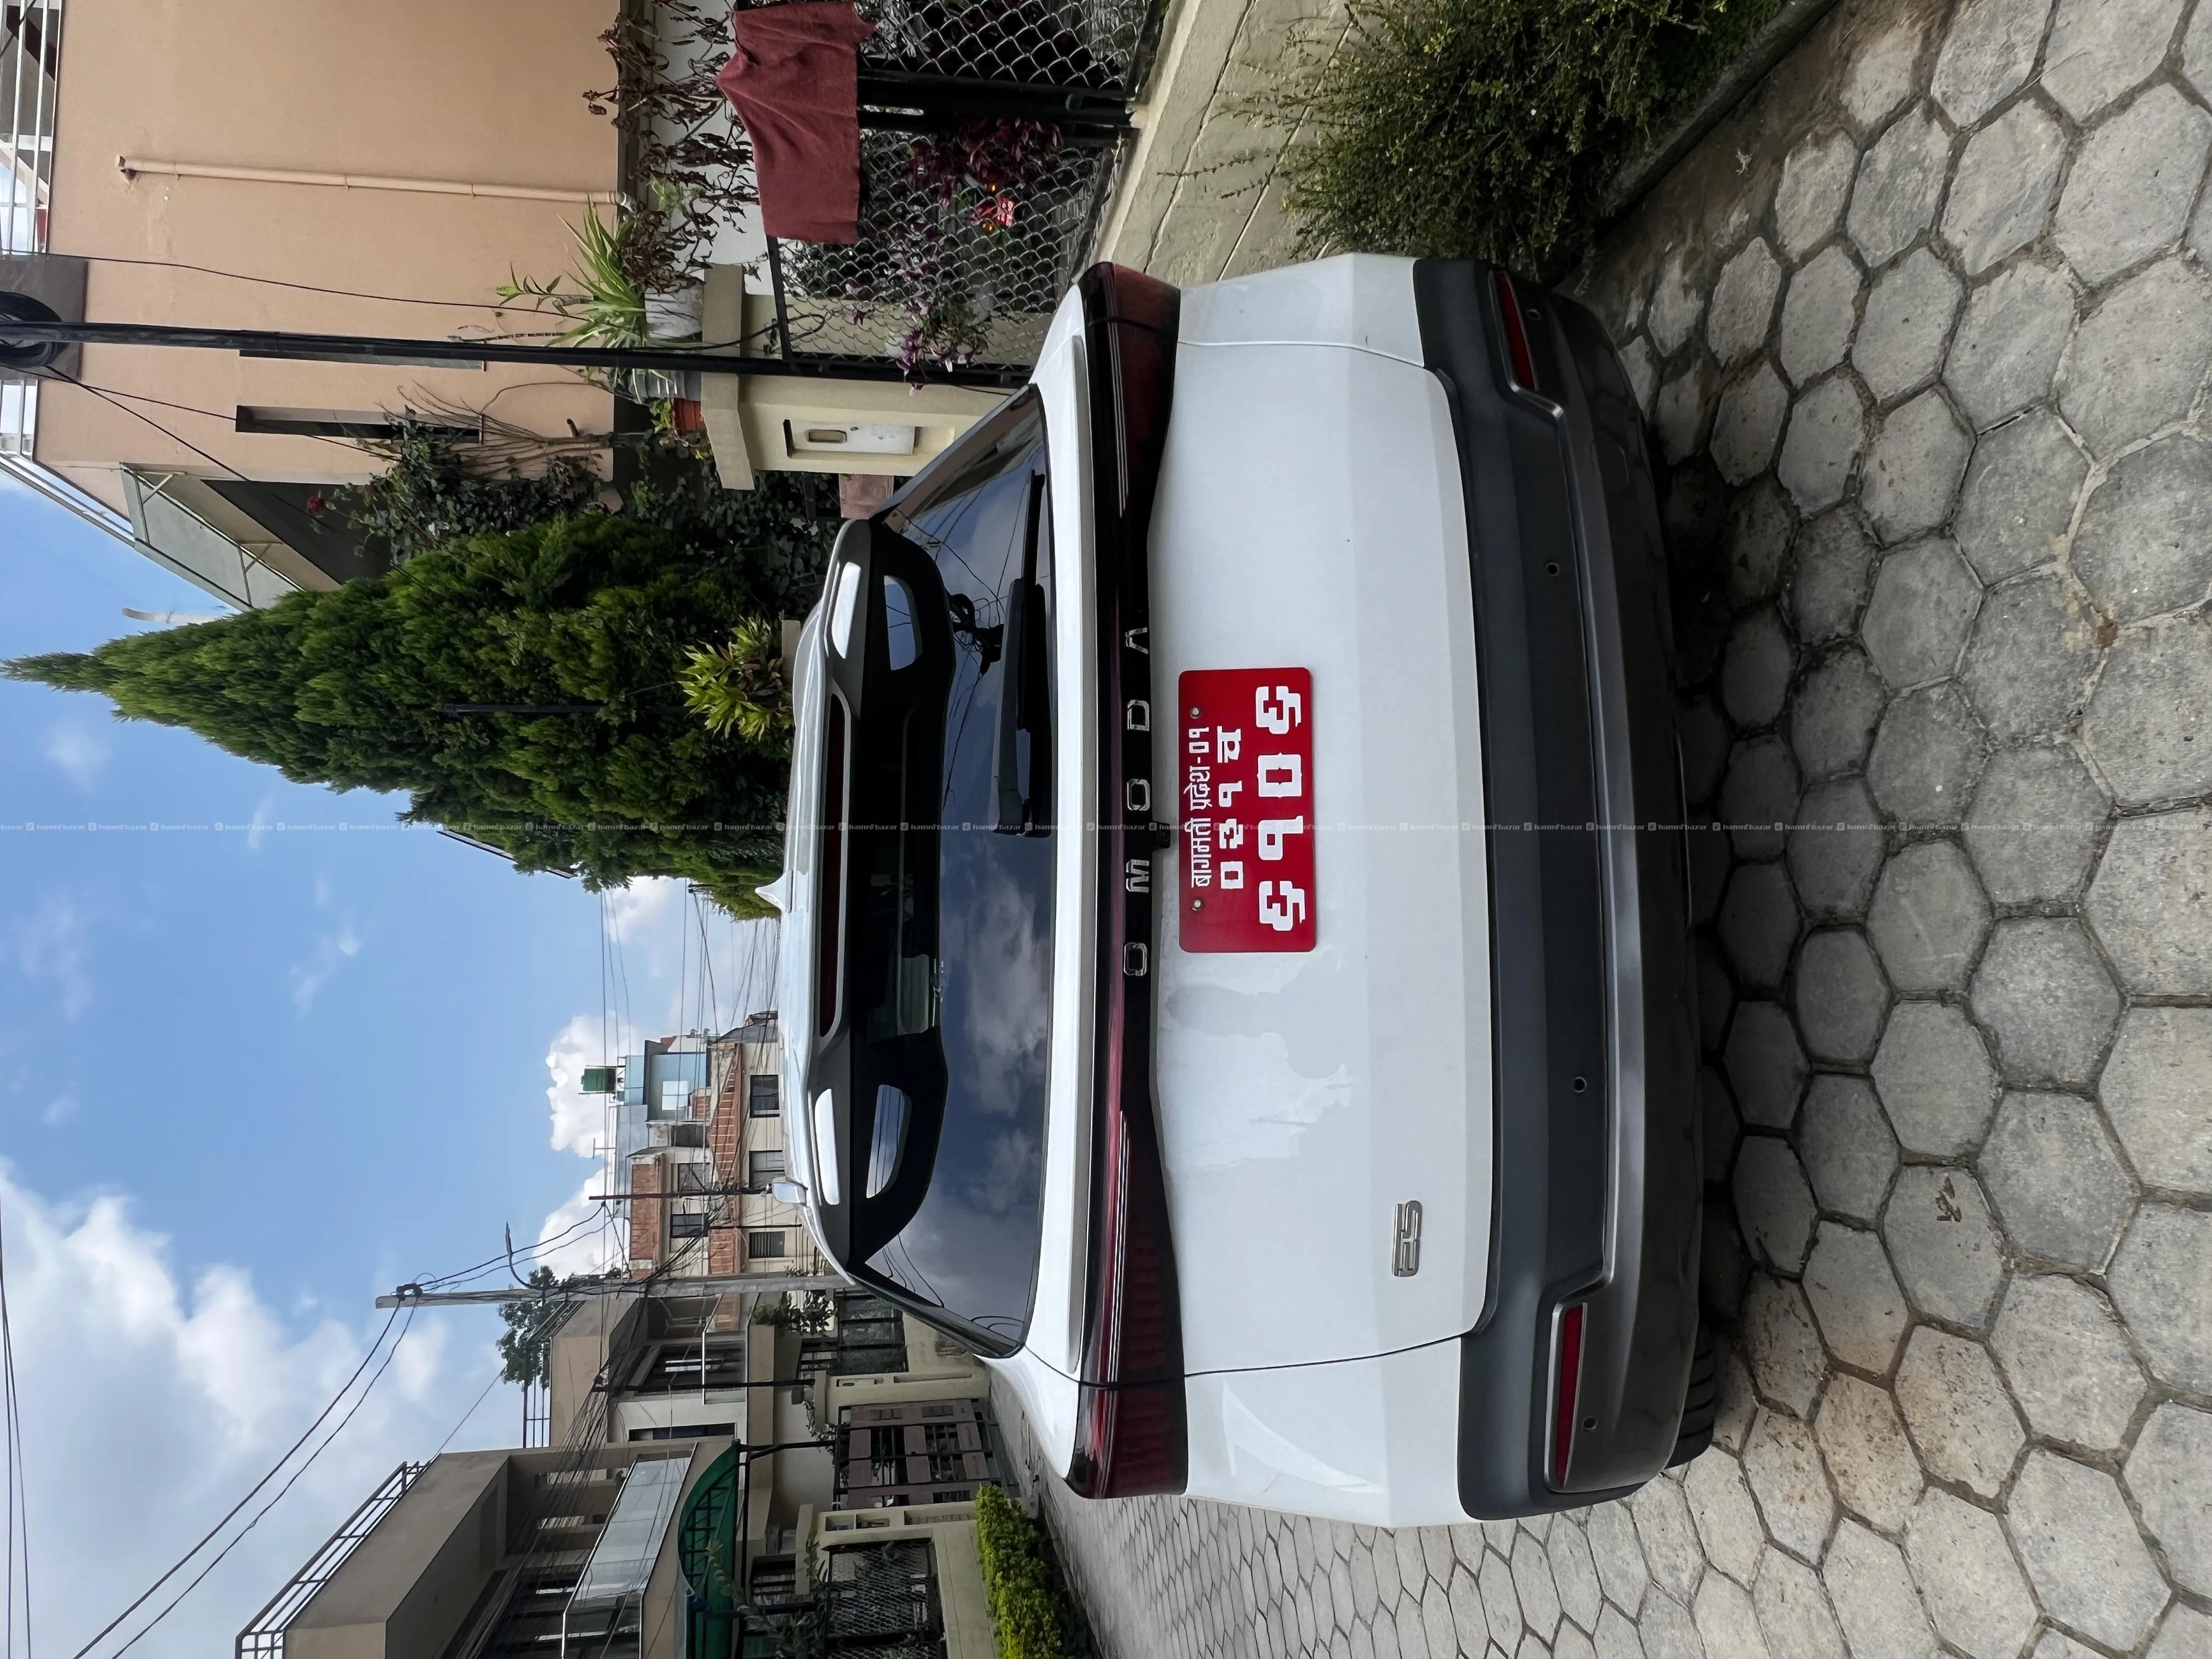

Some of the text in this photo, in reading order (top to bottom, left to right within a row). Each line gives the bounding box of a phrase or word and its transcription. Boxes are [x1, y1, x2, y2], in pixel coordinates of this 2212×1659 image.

[1217, 725, 1244, 890] ०३१ च
[1184, 817, 1212, 888] बागमती
[1391, 1200, 1423, 1277] E5
